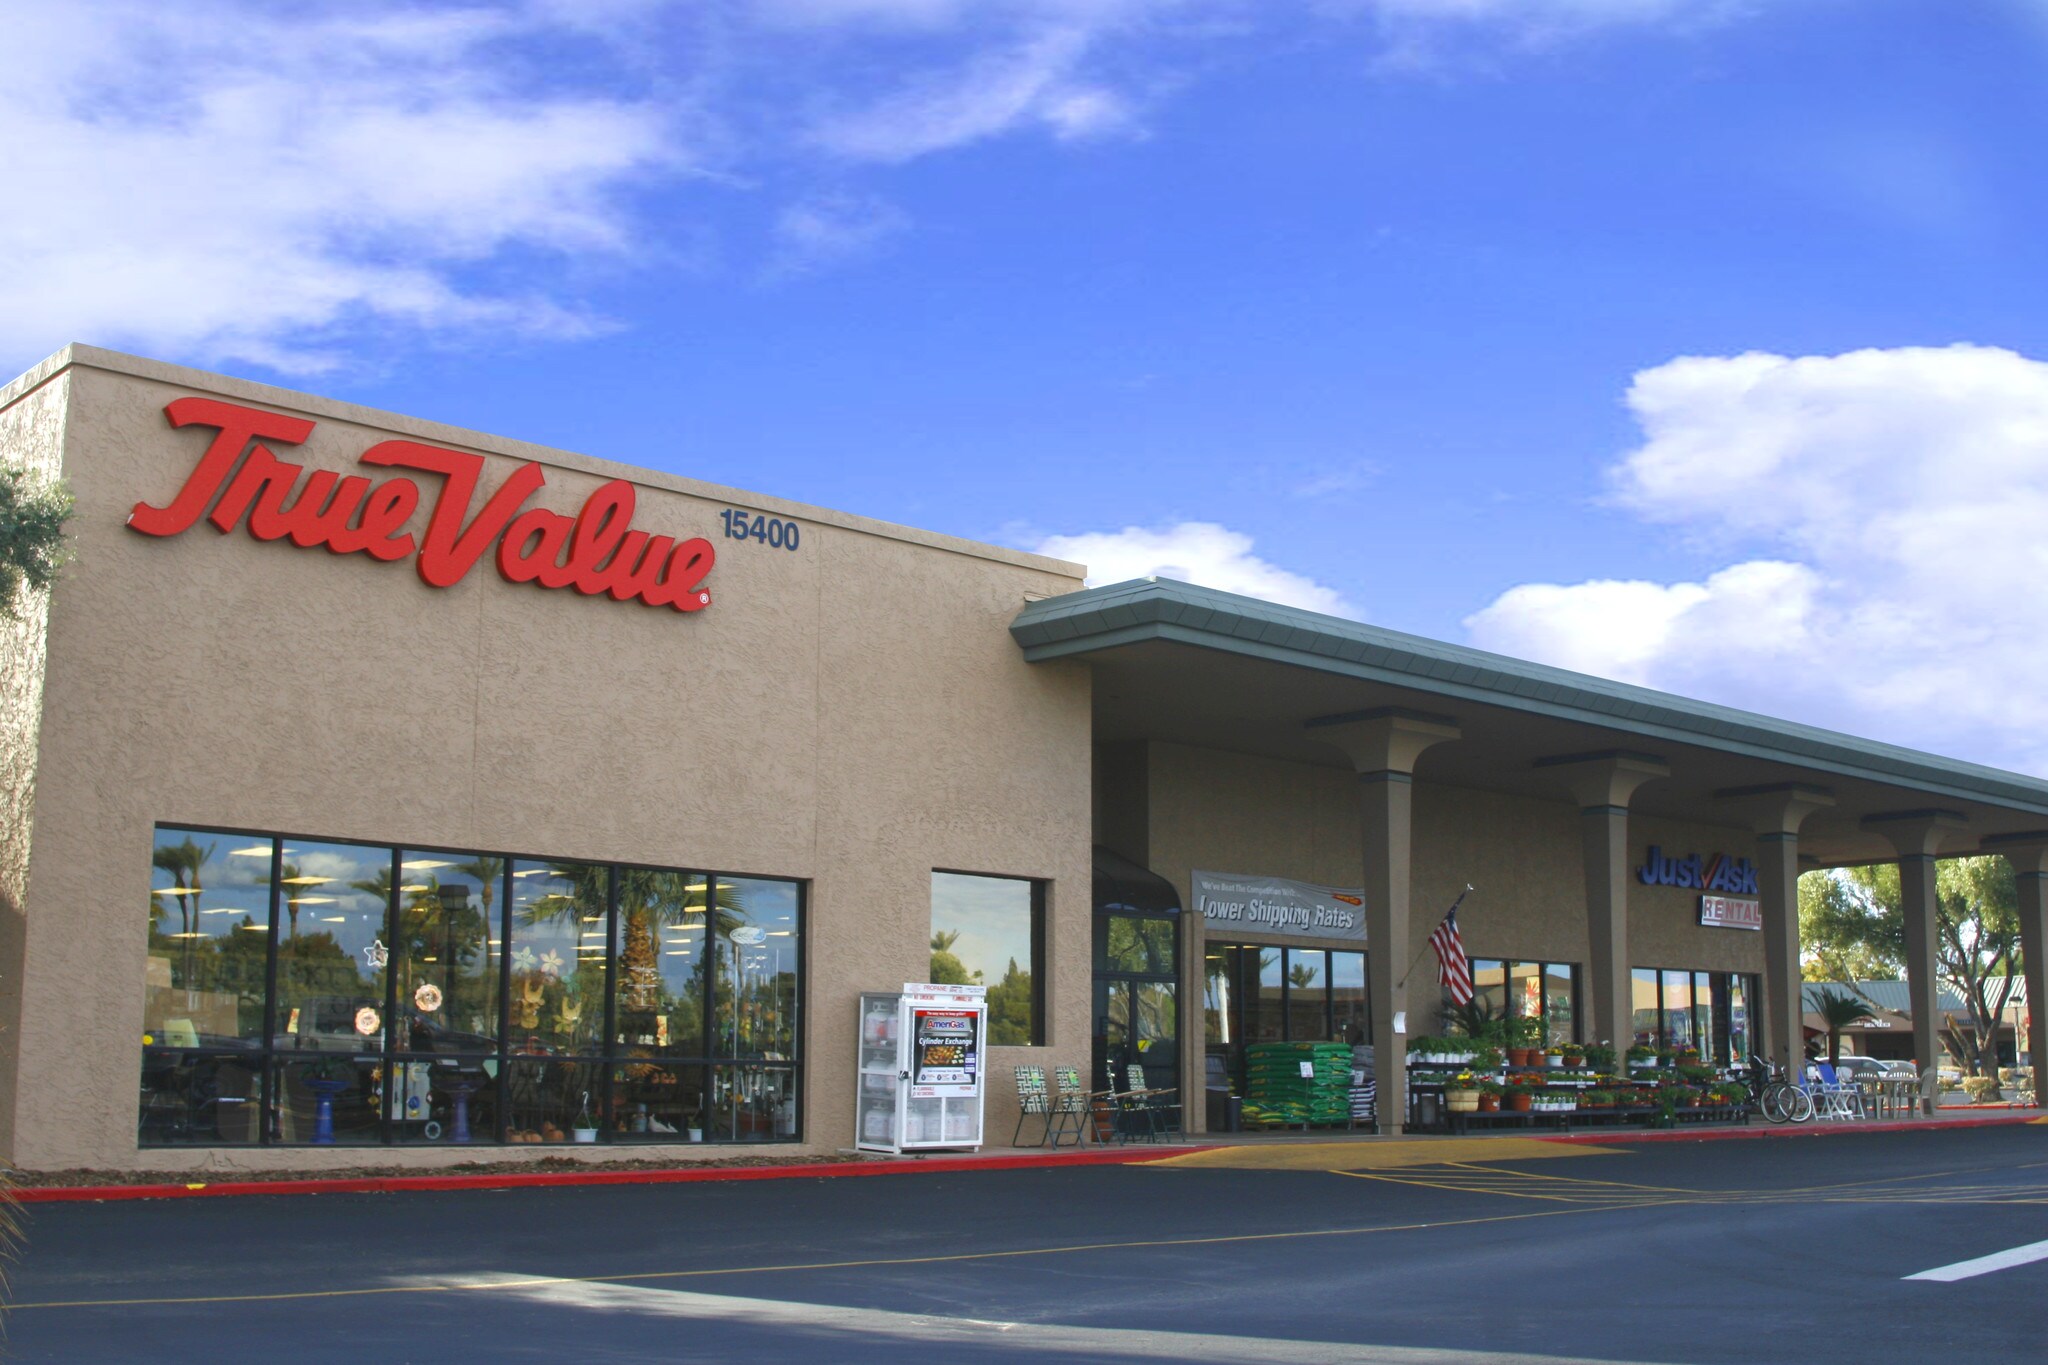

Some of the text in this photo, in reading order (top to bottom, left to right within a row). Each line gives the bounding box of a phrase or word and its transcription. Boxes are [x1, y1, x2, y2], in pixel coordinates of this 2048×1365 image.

[126, 397, 715, 612] True Value
[720, 508, 799, 551] 15400
[1638, 845, 1759, 894] Just Ask
[1201, 881, 1220, 890] We've
[1236, 884, 1246, 893] The
[1200, 895, 1245, 920] Lower
[1248, 899, 1312, 929] Shipping
[1314, 904, 1354, 929] Rates
[1704, 899, 1761, 921] RENTAL
[927, 1020, 965, 1029] AmeriGas
[918, 1037, 973, 1047] Cylinder Exchange
